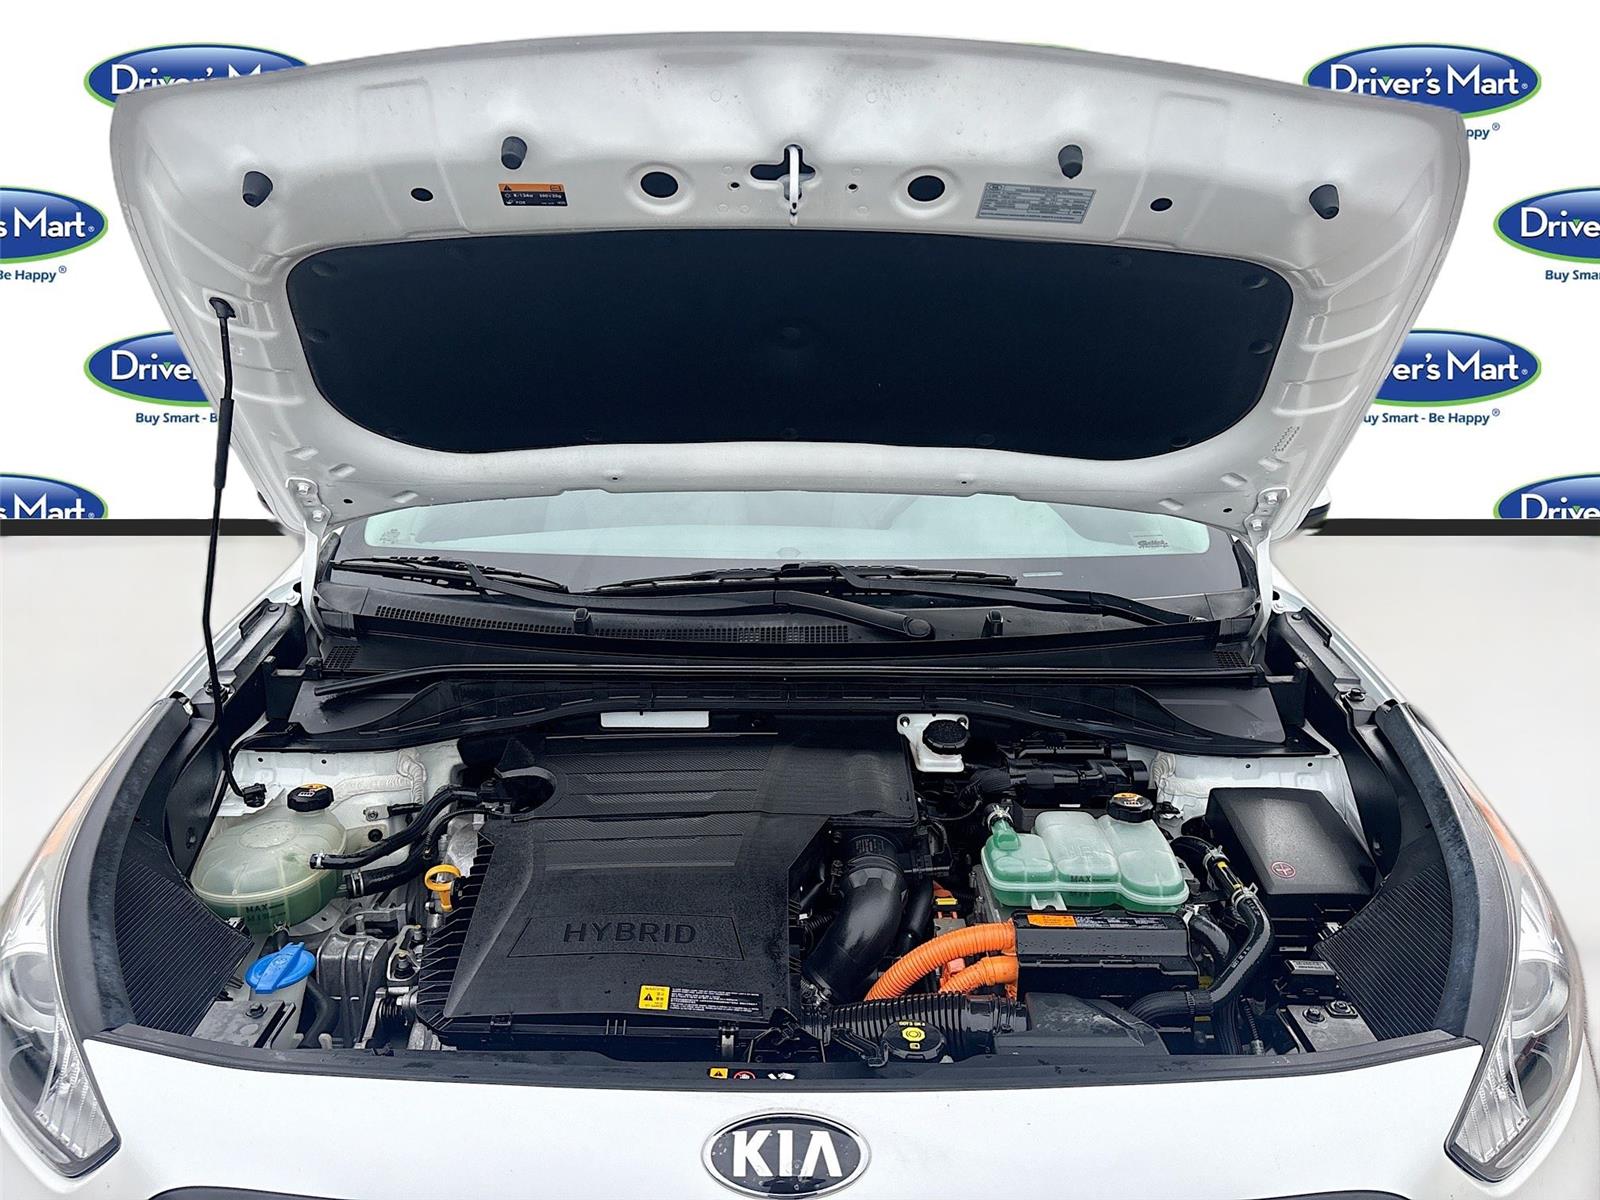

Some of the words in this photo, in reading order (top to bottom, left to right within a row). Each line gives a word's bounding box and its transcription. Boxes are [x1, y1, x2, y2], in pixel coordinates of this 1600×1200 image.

[1331, 64, 1440, 95] Driver's
[1447, 64, 1519, 94] Mart
[1466, 129, 1490, 140] ppy
[14, 206, 86, 237] Mart
[1521, 207, 1600, 238] Drive
[15, 270, 57, 283] Happy
[1545, 270, 1569, 283] Buy
[1572, 270, 1600, 280] Sma
[1447, 350, 1519, 380] Mart
[136, 413, 160, 426] Buy
[163, 413, 200, 423] Smart
[1363, 415, 1379, 426] uy
[1382, 413, 1419, 423] Smart
[1429, 413, 1445, 423] Be
[1449, 413, 1490, 426] Happy
[14, 492, 86, 519] Mart
[1070, 875, 1091, 883] MAX
[563, 921, 697, 944] HYBRID
[732, 1129, 843, 1178] KIA
